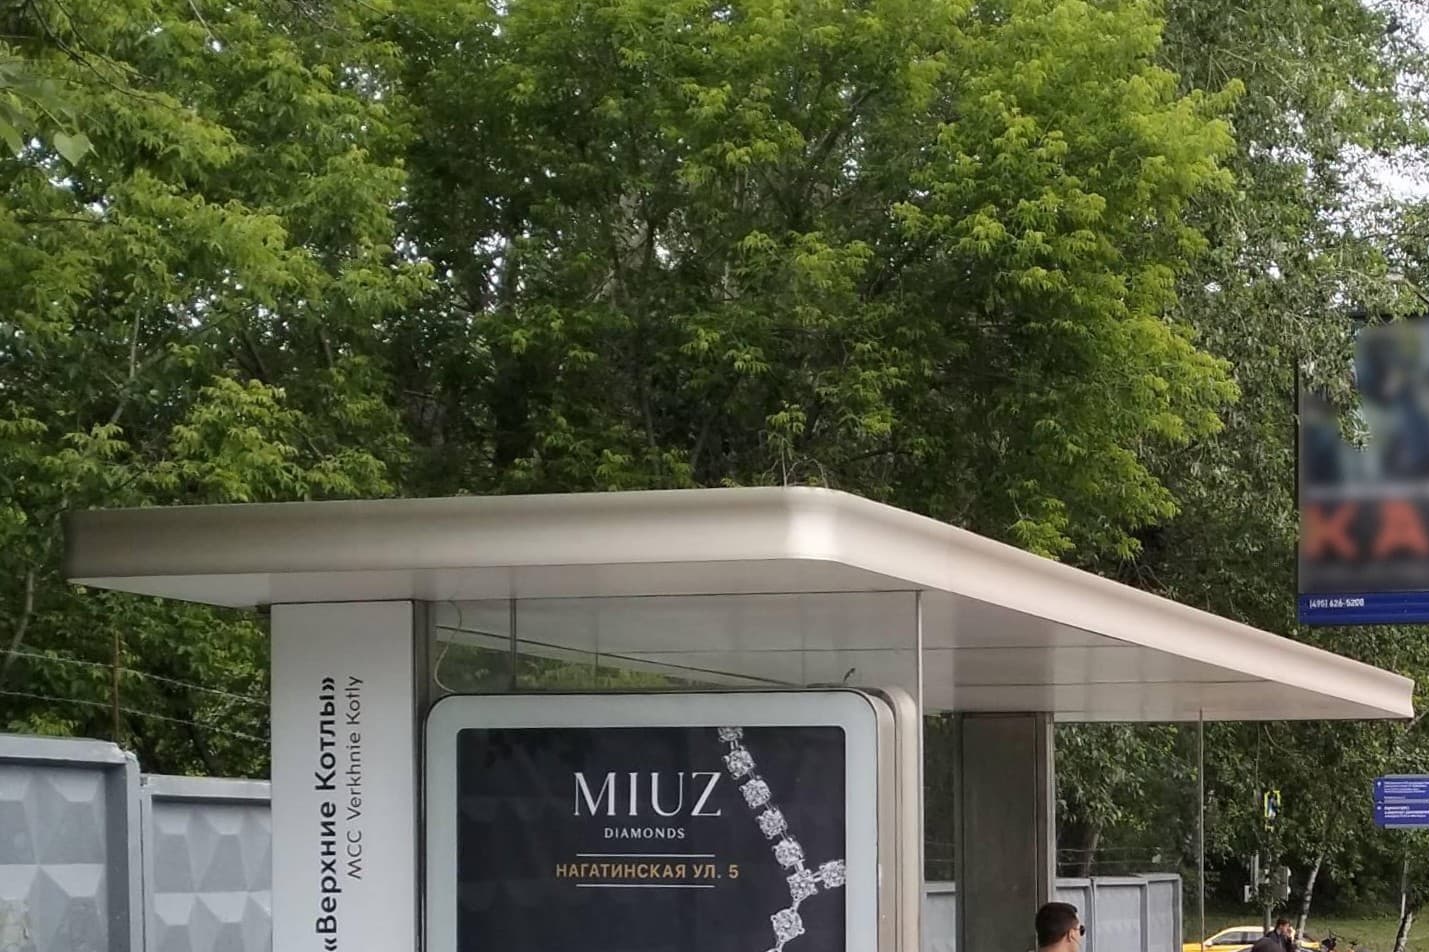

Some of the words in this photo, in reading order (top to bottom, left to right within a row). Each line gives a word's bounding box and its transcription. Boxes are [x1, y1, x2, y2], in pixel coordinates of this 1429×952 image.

[345, 675, 364, 725] Kotly
[314, 677, 337, 791] Котлы»
[346, 733, 362, 821] Verkhnie
[573, 771, 722, 817] MIUZ
[347, 831, 362, 879] MCC
[605, 828, 684, 838] DIAMONDS
[316, 802, 341, 951] «Верхние
[557, 864, 685, 878] НАГАТИНСКАЯ
[693, 865, 721, 878] УЛ.
[729, 865, 738, 878] 5
